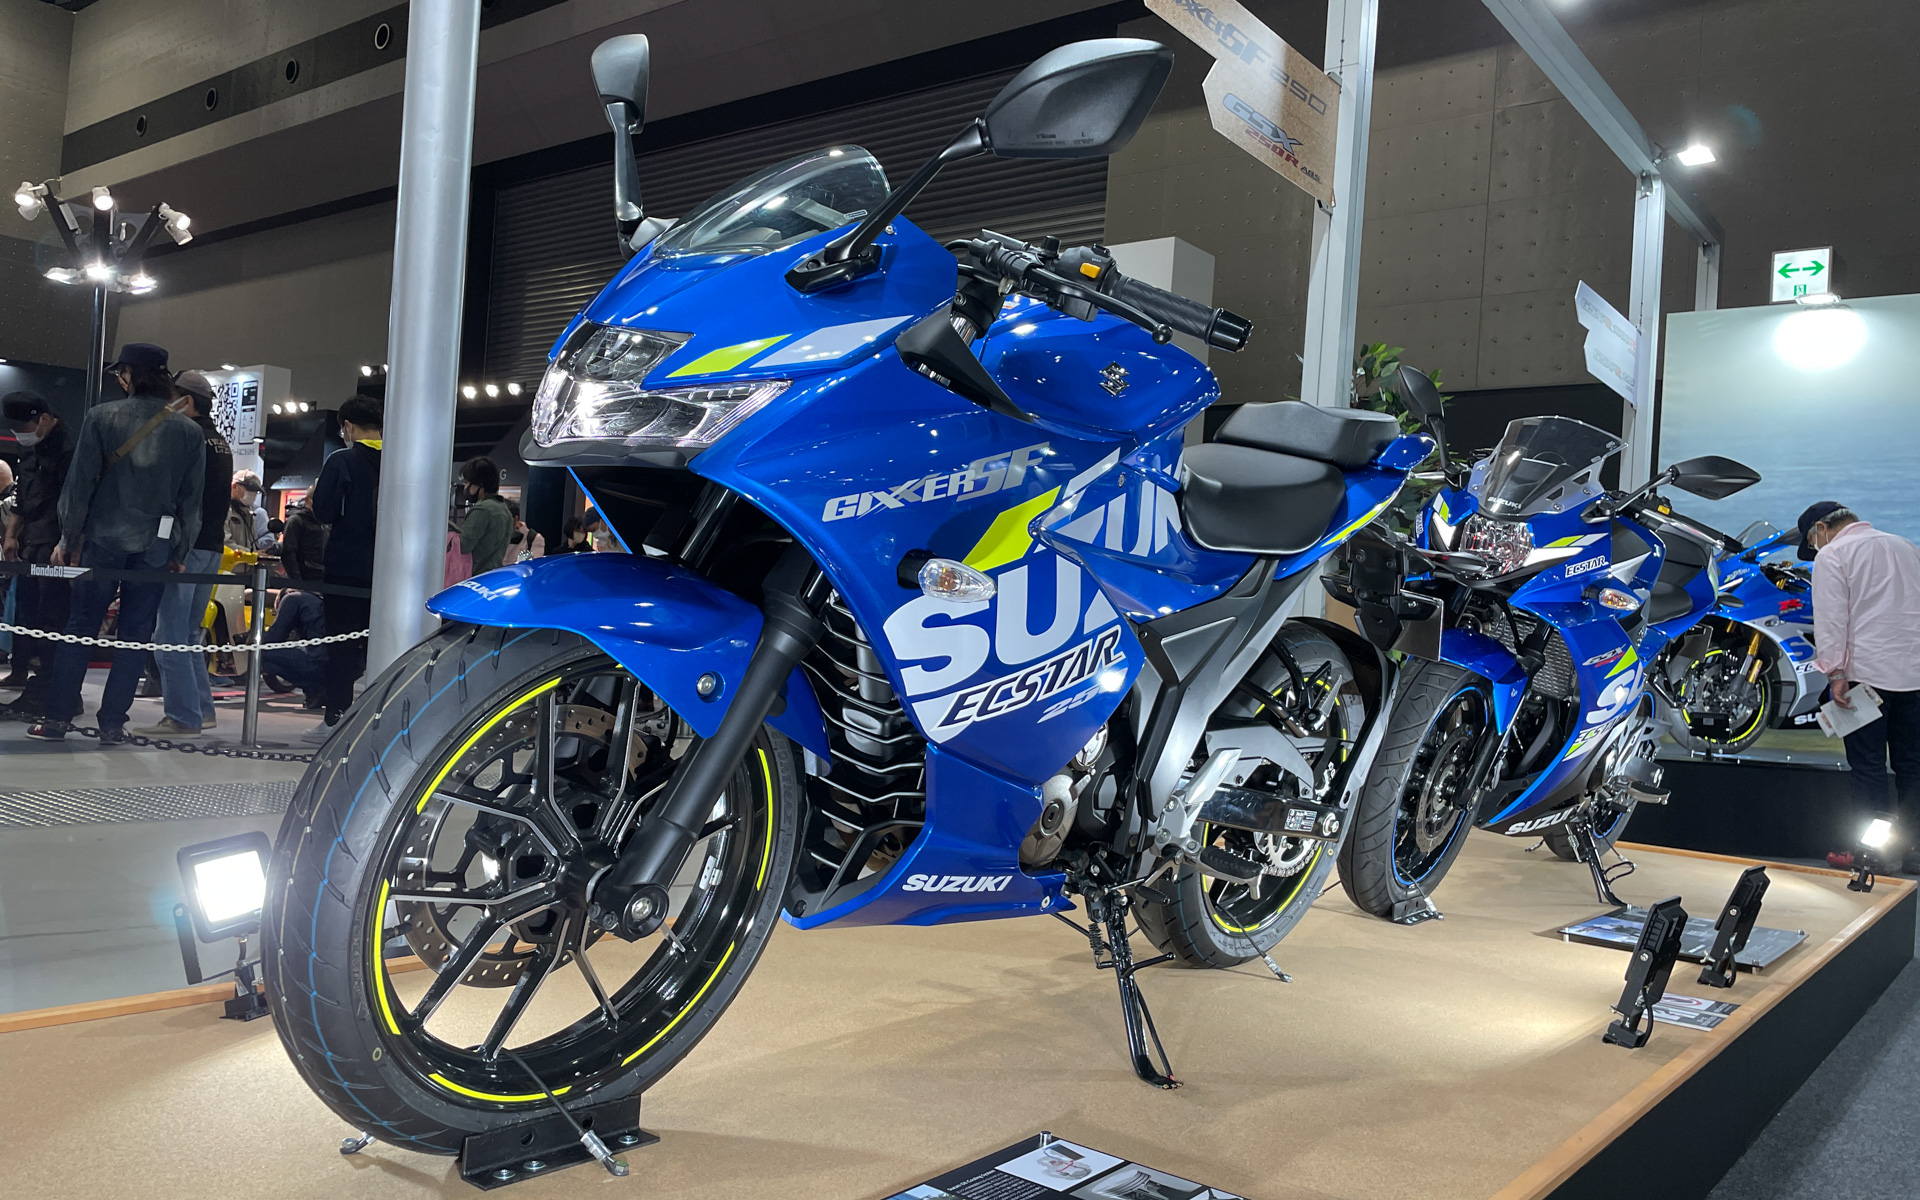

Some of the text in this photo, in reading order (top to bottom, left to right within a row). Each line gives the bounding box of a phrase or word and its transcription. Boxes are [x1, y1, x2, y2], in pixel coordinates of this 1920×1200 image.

[1270, 64, 1327, 116] 250
[1222, 93, 1303, 156] GSX
[1300, 166, 1322, 185] ABS
[1488, 497, 1521, 509] SUZUKI
[30, 564, 64, 577] HondaGO
[1565, 555, 1609, 578] ECSTAR
[930, 625, 1126, 732] ECSTAR
[902, 874, 1013, 892] SUZUKI
